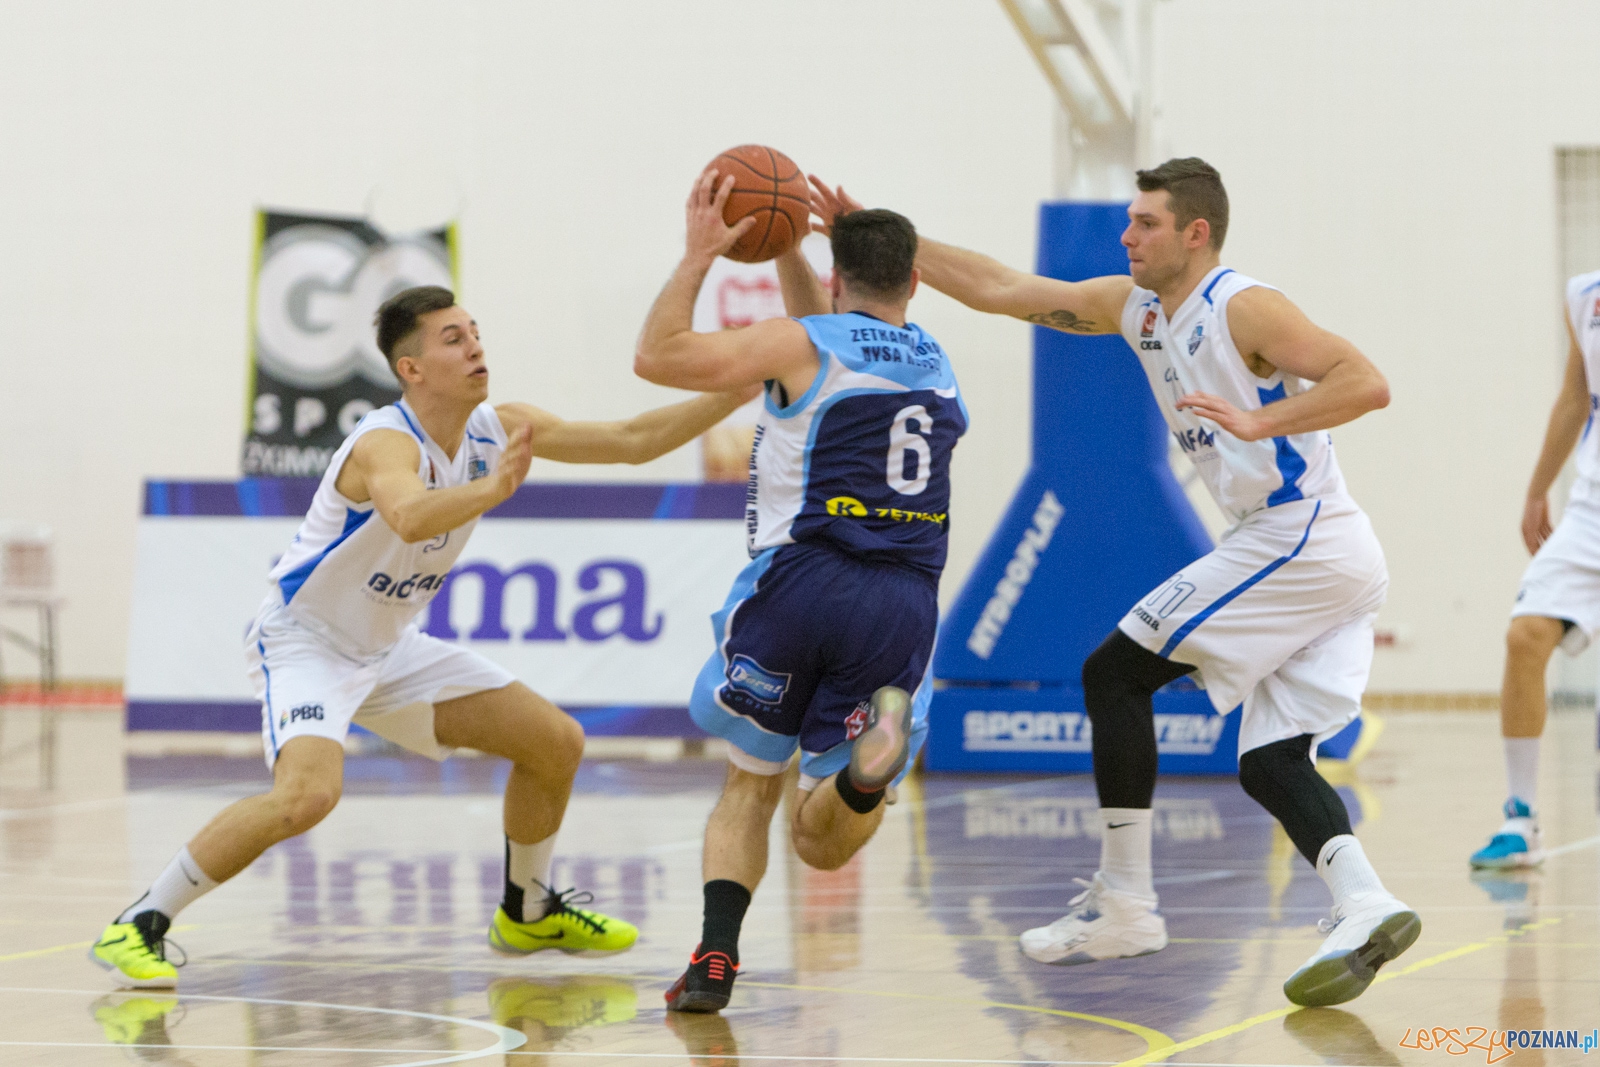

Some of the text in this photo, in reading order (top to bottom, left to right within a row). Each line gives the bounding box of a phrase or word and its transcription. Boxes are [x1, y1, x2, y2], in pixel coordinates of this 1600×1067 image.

[886, 404, 933, 495] 6
[415, 558, 664, 643] ma
[967, 489, 1065, 660] HYDROPLAY
[1146, 573, 1196, 619] 11
[291, 704, 324, 722] PBG
